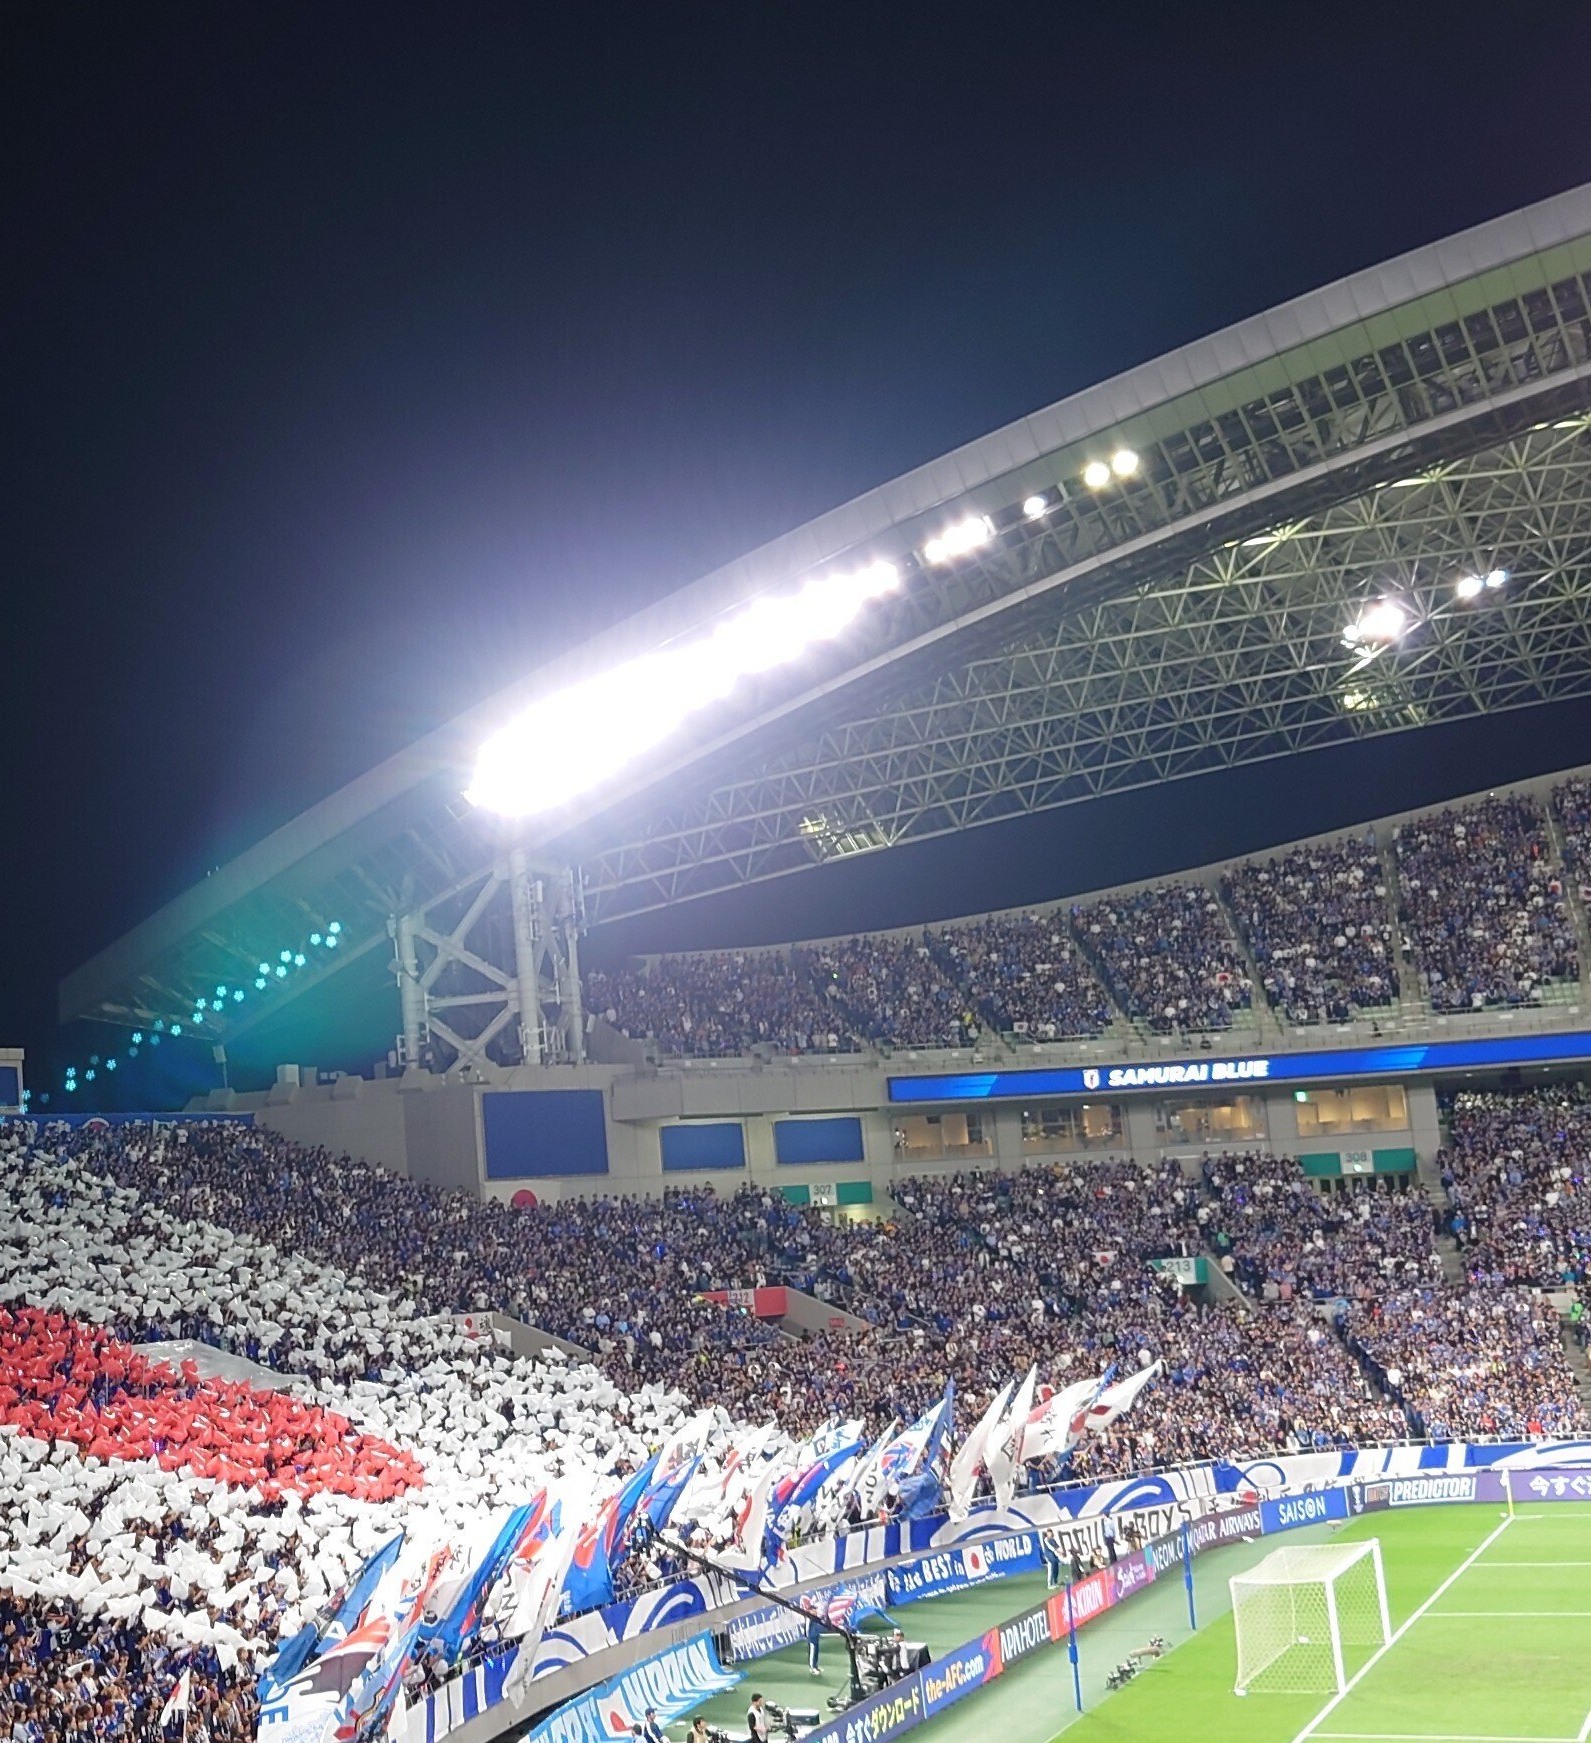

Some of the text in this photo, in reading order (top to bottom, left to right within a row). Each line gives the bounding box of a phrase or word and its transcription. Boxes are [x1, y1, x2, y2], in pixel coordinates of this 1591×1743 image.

[1108, 1060, 1270, 1087] SAMURAI BLUE
[1345, 1151, 1367, 1163] 308
[813, 1184, 831, 1195] 307
[1166, 1260, 1191, 1272] 213
[1393, 1477, 1471, 1500] PREDICTOR
[1278, 1496, 1326, 1525] SAISON
[1193, 1510, 1260, 1549] QATAR AIRWAYS
[921, 1552, 953, 1583] BEST
[994, 1534, 1032, 1562] WORLD
[1075, 1578, 1103, 1618] KIRIN
[1019, 1609, 1050, 1651] HOTEL
[925, 1654, 985, 1703] the-AFC.com
